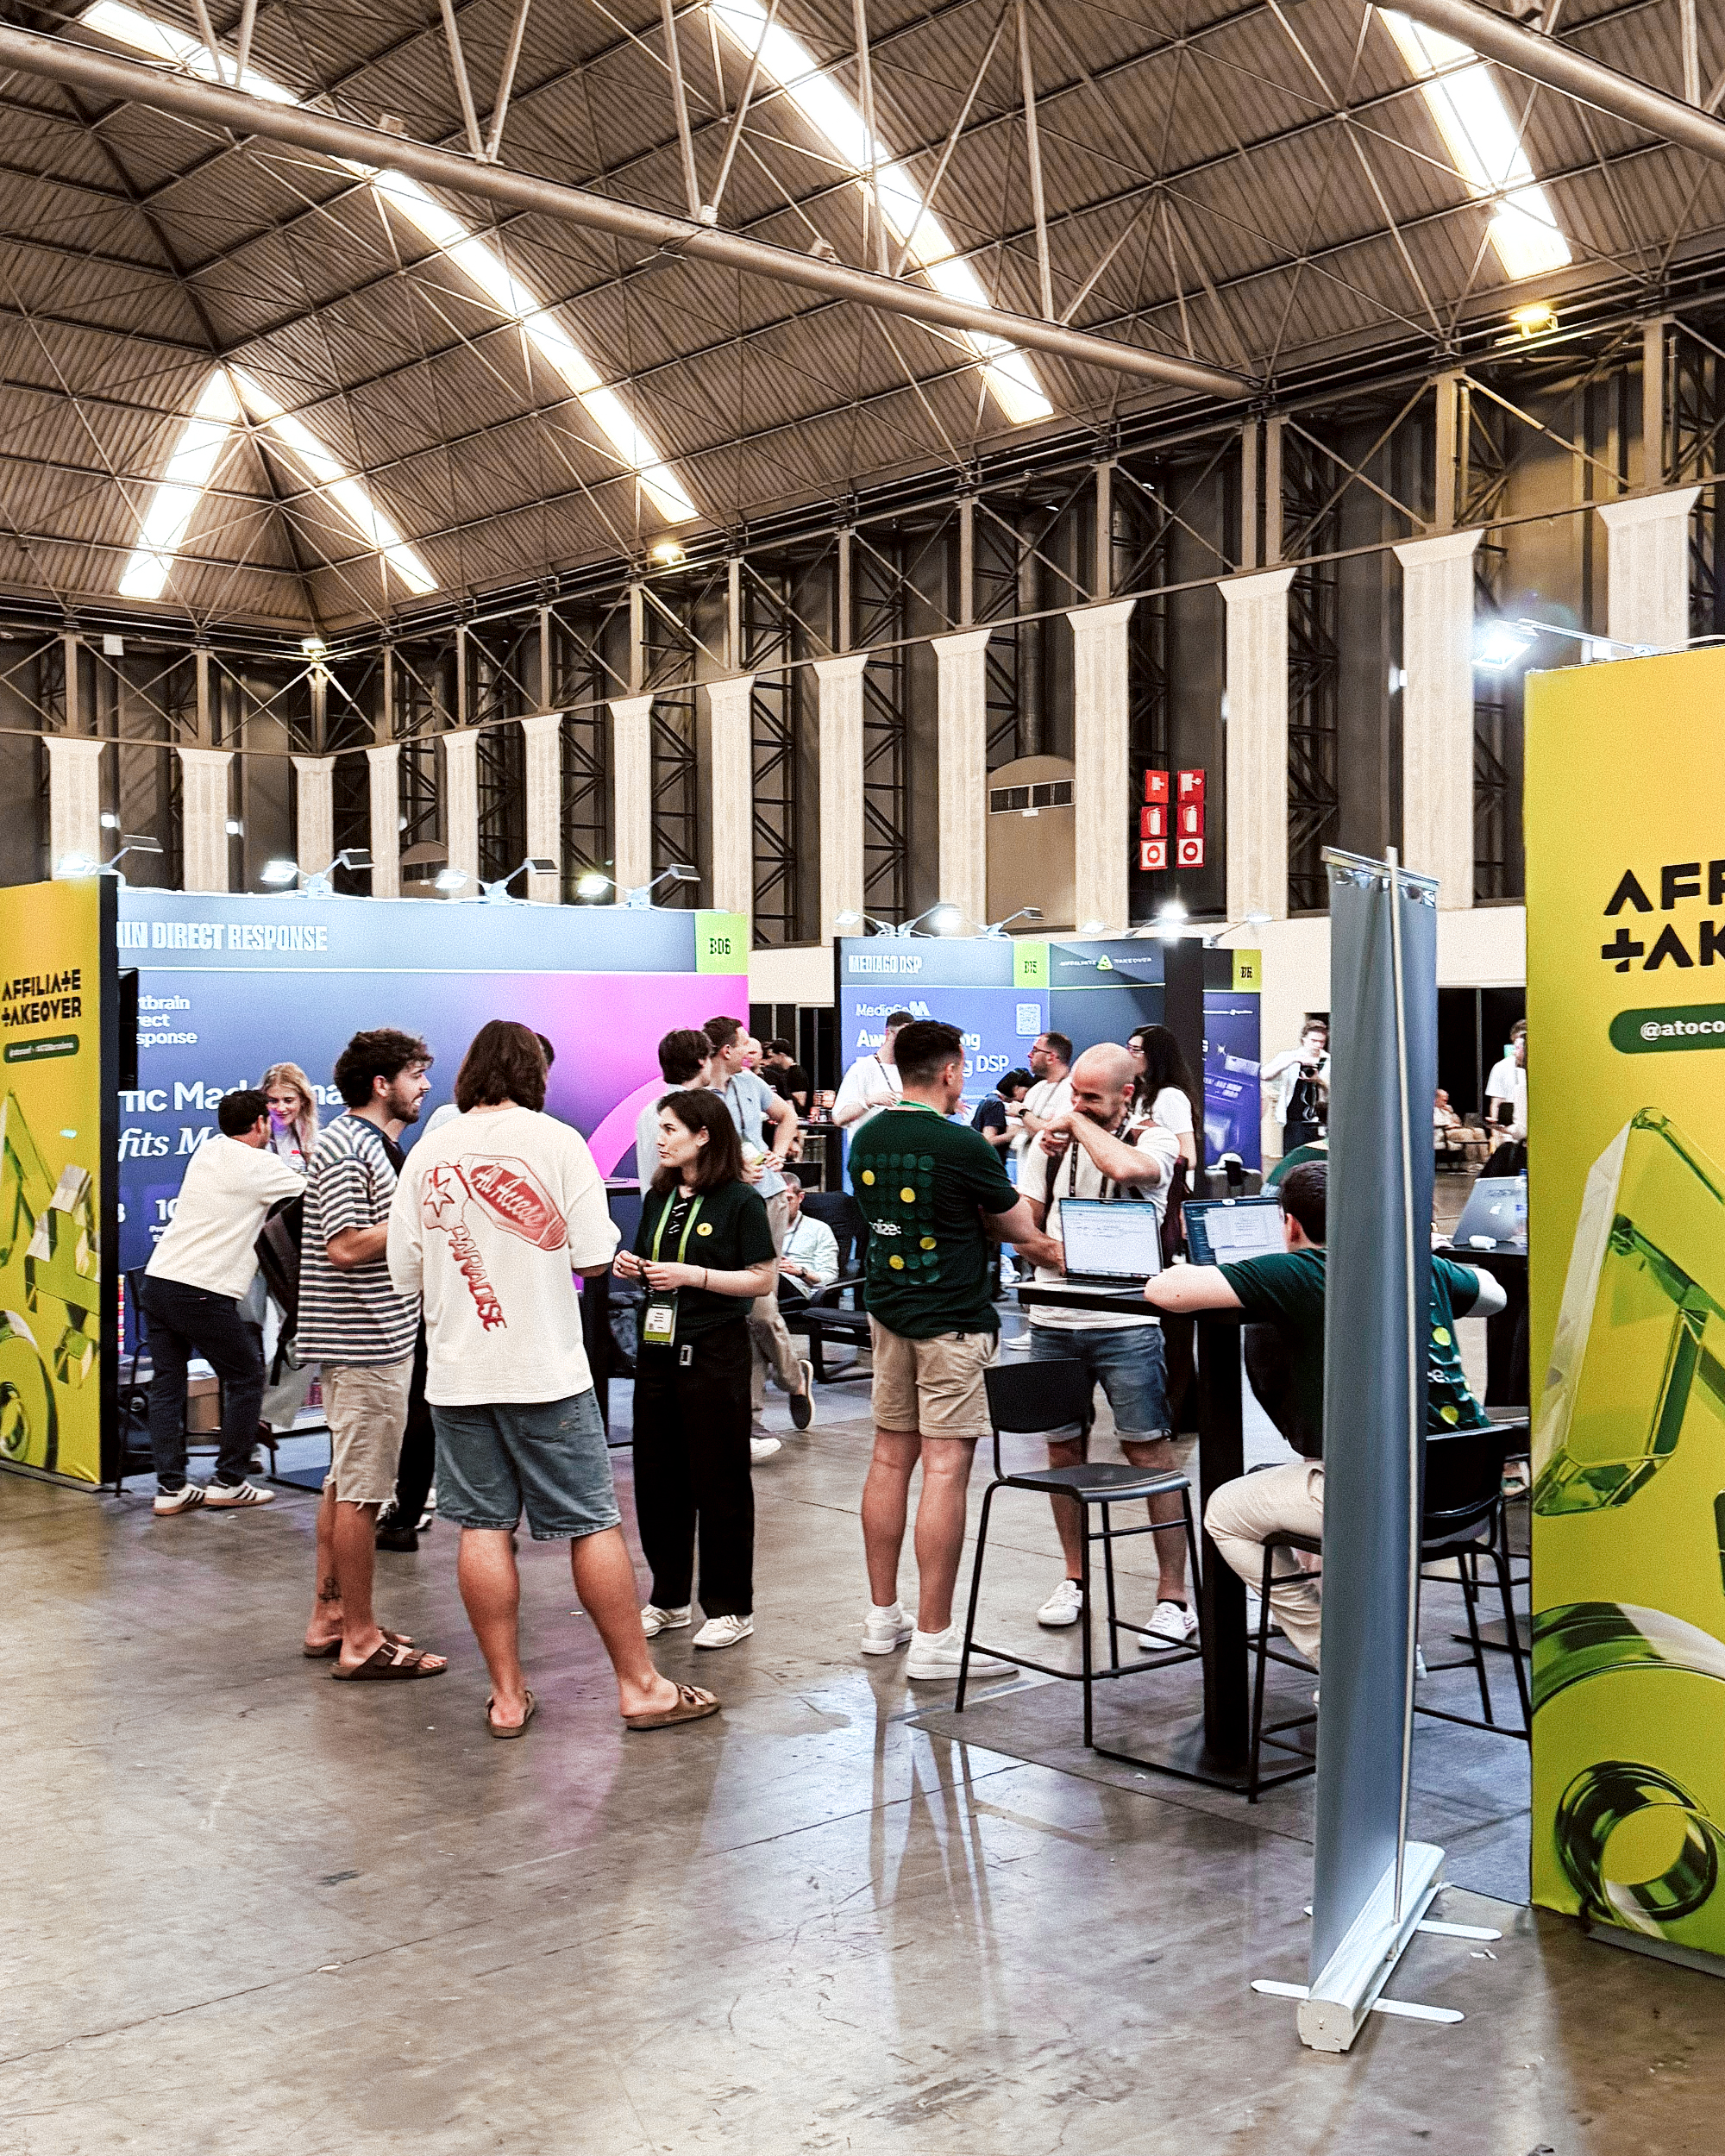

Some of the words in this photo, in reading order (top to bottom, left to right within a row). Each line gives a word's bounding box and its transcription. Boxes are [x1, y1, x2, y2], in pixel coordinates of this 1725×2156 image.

[152, 922, 224, 950] DIRECT
[228, 924, 328, 951] RESPONSE
[849, 956, 898, 973] MEDIAGO
[900, 956, 922, 974] DSP
[2, 968, 81, 1001] AFFILIATE
[2, 996, 81, 1027] TAKEOVER
[138, 994, 190, 1010] tbrain
[136, 1032, 198, 1048] sponse
[975, 1055, 1009, 1072] DSP
[117, 1127, 170, 1163] fits
[448, 1225, 508, 1332] PARADISE
